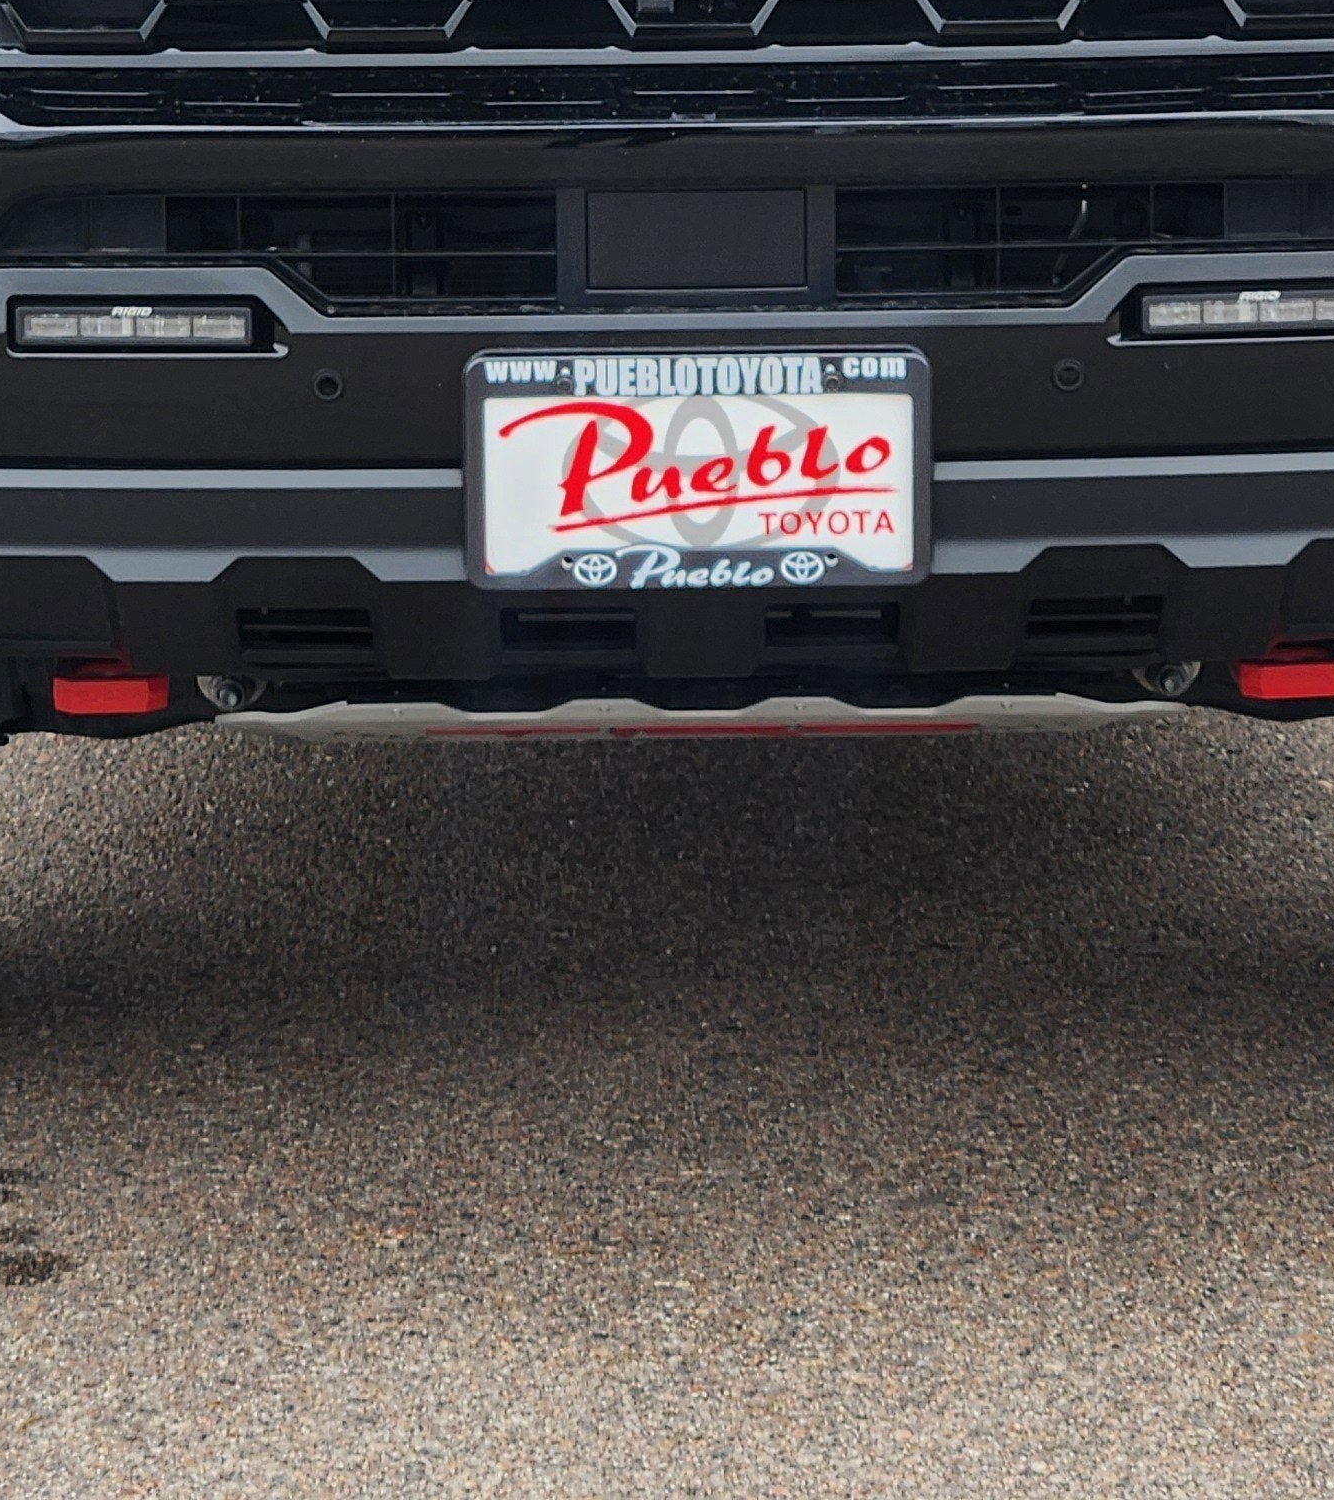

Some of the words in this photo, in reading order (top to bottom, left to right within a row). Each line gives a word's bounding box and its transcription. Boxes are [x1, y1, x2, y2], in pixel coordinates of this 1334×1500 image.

[498, 401, 891, 517] Pueblo
[758, 510, 895, 536] TOYOTA
[615, 543, 774, 589] Pueblo
